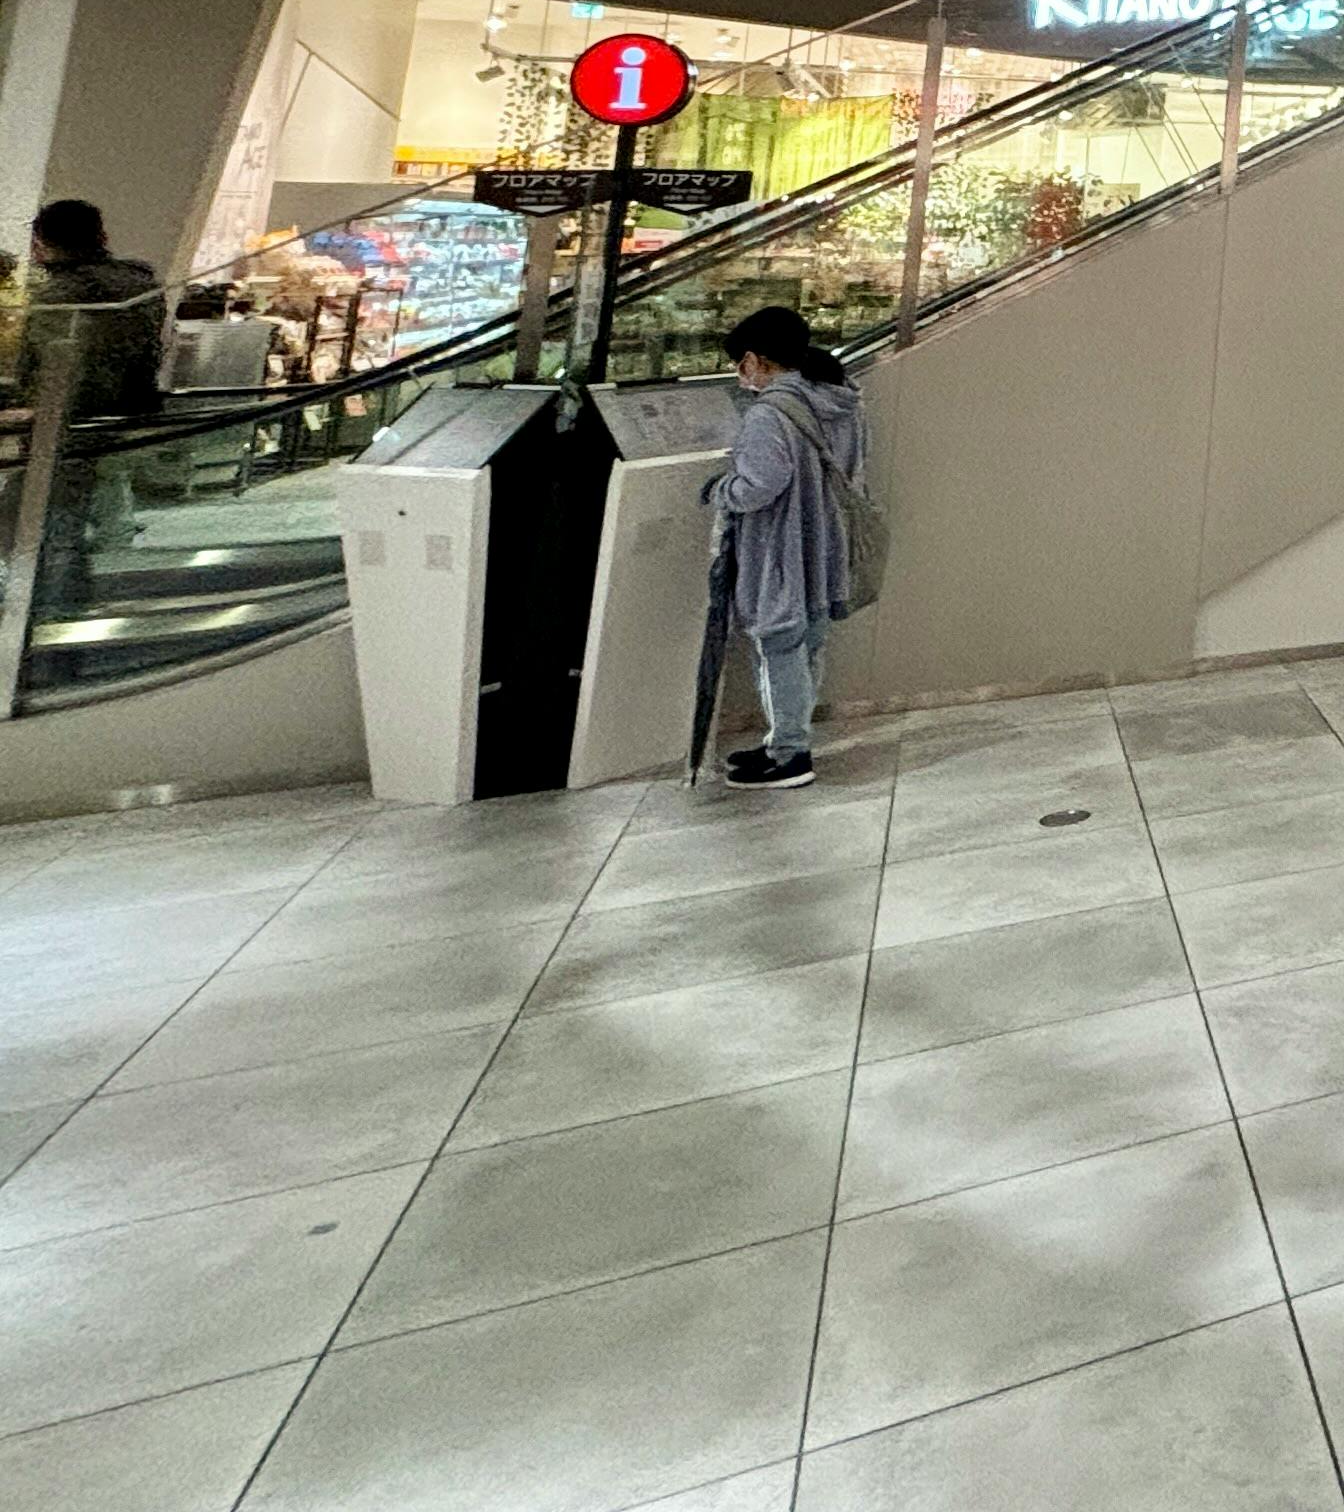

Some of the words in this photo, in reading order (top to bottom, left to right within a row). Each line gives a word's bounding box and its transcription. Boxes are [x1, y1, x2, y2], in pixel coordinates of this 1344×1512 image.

[491, 173, 599, 189] フロアマップ
[642, 172, 738, 188] フロアマップ
